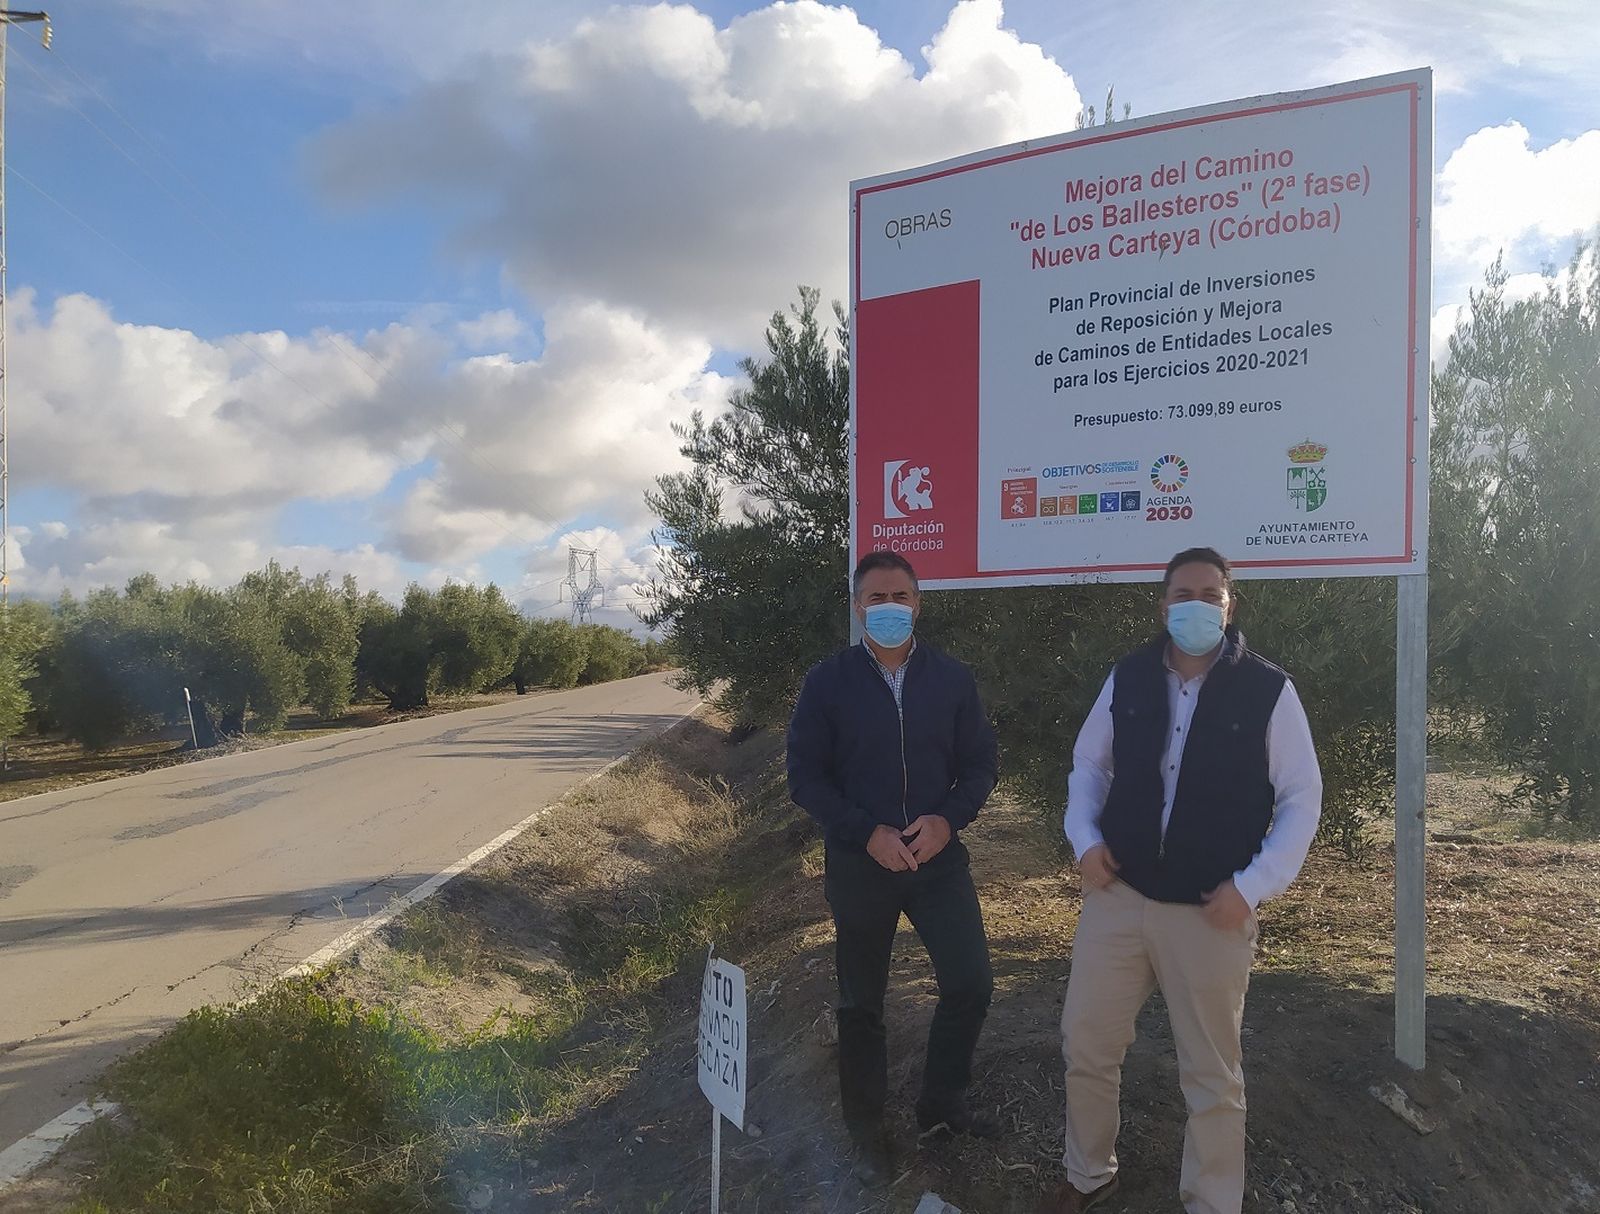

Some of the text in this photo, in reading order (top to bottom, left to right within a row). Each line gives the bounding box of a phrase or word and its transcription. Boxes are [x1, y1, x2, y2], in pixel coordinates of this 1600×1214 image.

[1065, 148, 1294, 204] Mejora del Camino
[1010, 165, 1371, 243] "de Los Ballesteros" (2ª fase)
[885, 208, 952, 239] OBRAS
[1031, 203, 1342, 270] Nueva Carteya (Córdoba)
[1049, 268, 1316, 314] Plan Provincial de Inversiones
[1076, 298, 1283, 336] de Reposición y Mejora
[1034, 320, 1333, 367] de Caminos de Entidades Locales
[1053, 348, 1310, 393] para los Ejercicios 2020-2021
[1073, 400, 1283, 428] Presupuesto: 73.099,89 euros
[1042, 464, 1102, 479] OBJETIVOS
[1146, 496, 1192, 507] AGENDA
[1146, 506, 1194, 522] 2030
[873, 520, 944, 539] Diputación
[1246, 532, 1369, 546] DE NUEVA CARTEYA
[1259, 521, 1355, 534] AYUNTAMIENTO
[873, 538, 944, 553] de Córdoba
